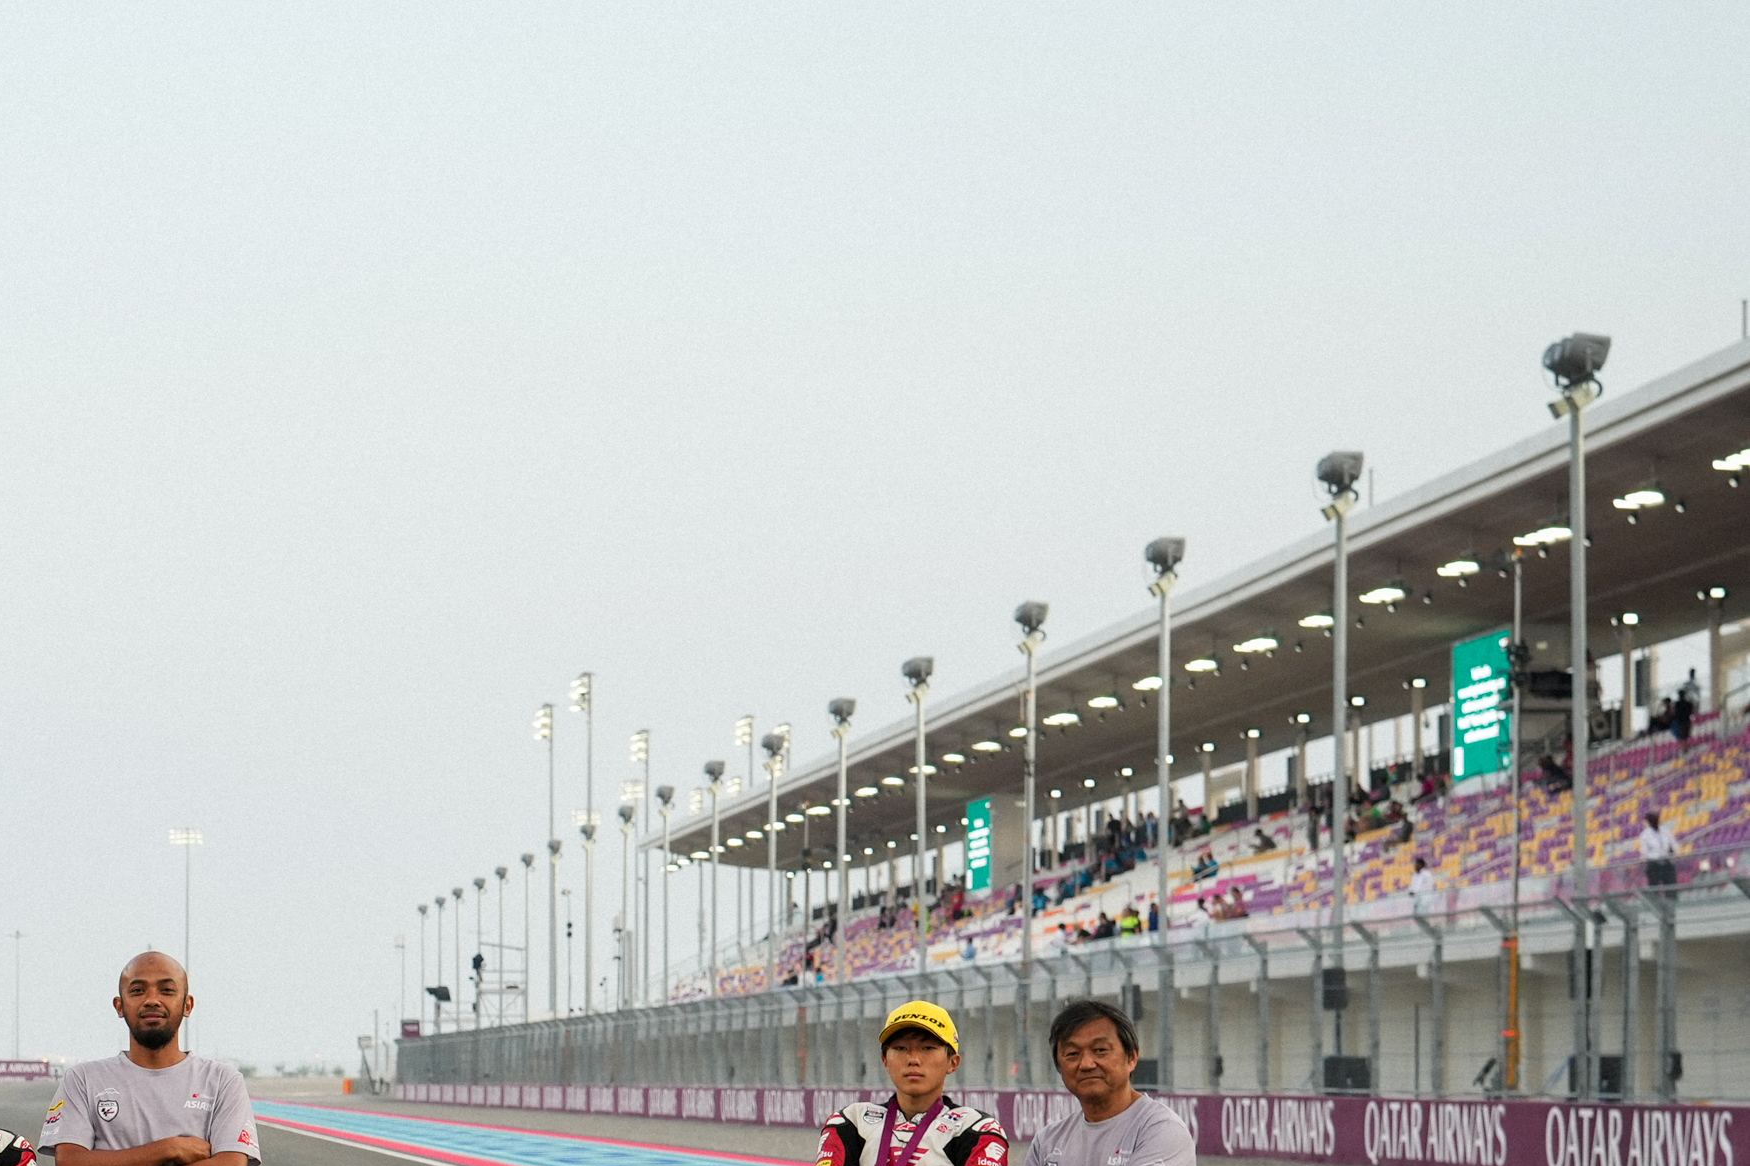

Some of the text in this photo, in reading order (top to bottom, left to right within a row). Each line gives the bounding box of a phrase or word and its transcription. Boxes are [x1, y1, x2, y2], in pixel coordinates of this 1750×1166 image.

[893, 1013, 946, 1029] DUNLOP
[1221, 1096, 1269, 1156] QATAR
[1270, 1099, 1336, 1157] AIRWAYS
[1364, 1100, 1423, 1166] QATAR
